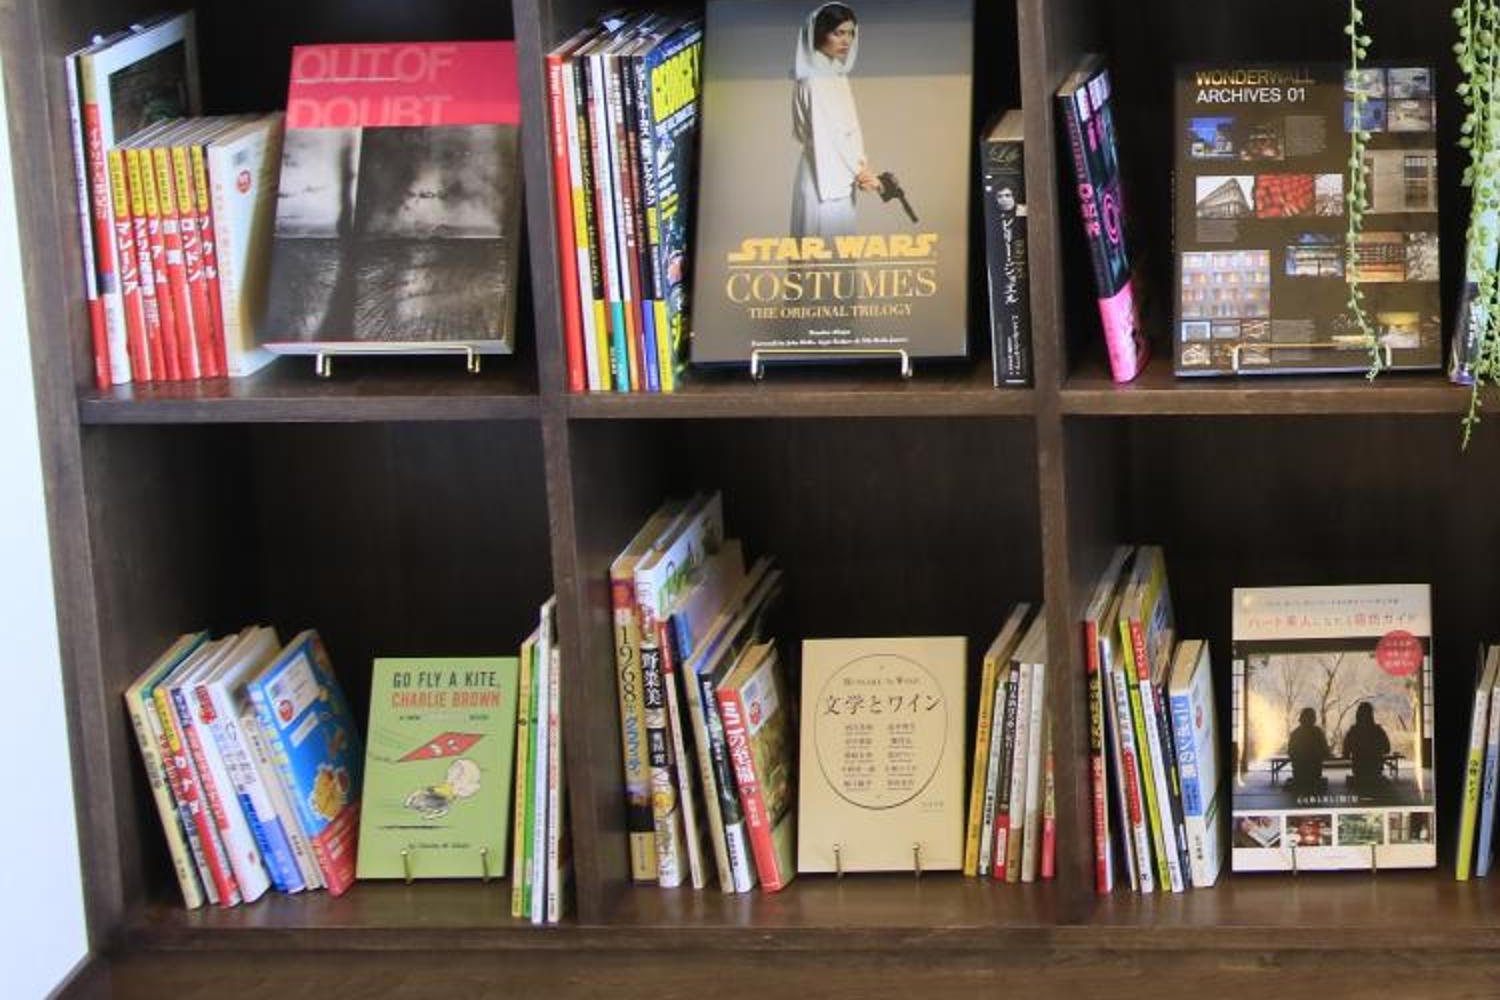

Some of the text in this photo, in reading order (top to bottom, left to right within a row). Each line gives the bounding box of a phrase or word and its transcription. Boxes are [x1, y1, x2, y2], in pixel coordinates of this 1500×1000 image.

[296, 45, 457, 85] OUT OF
[1195, 69, 1315, 86] WONDERWALL
[1196, 86, 1305, 103] ARCHIVES 01
[290, 95, 454, 129] DOUBT
[116, 221, 139, 296] マレーシア
[181, 218, 201, 282] ロンドン
[727, 233, 939, 262] STAR WARS
[726, 266, 938, 303] COSTUMES
[750, 303, 912, 319] THE ORIGINAL TRILOGY
[393, 671, 411, 688] GO
[418, 670, 442, 688] FLY
[449, 670, 457, 687] A
[391, 691, 502, 708] CHARLIE BROWN
[823, 693, 941, 715] 文学とワイン
